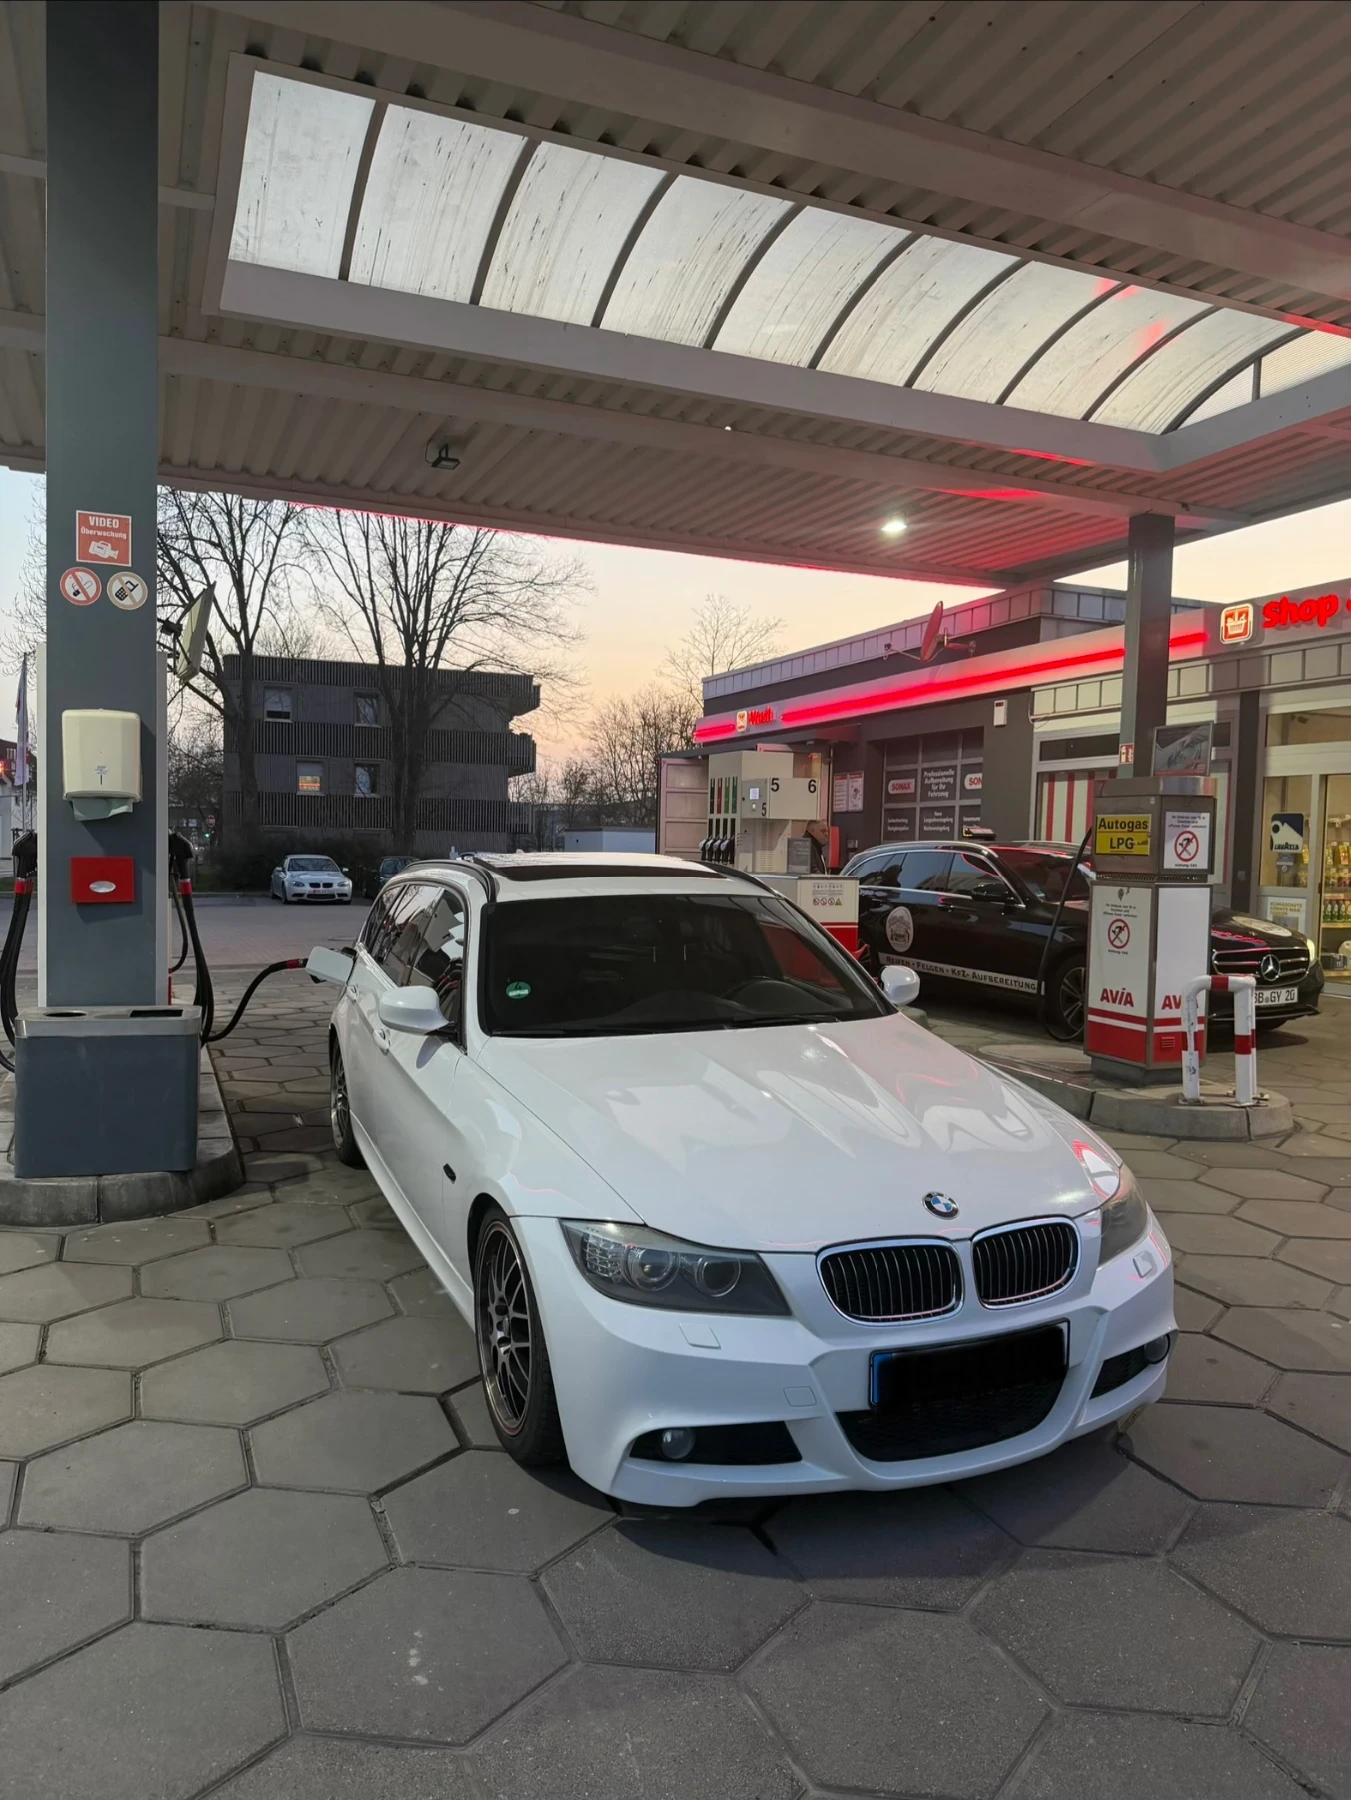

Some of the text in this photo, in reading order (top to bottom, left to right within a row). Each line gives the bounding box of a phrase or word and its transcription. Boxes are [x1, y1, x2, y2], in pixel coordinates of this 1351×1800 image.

[89, 516, 120, 528] VIDEO
[80, 526, 127, 540] Überwachung
[924, 769, 955, 777] Professionelle
[924, 776, 954, 784] Aufbereitung
[771, 778, 780, 792] 5
[808, 779, 817, 794] 6
[891, 782, 912, 791] SONAX
[927, 790, 949, 798] Fahrzeug
[761, 802, 767, 817] 5
[1098, 818, 1149, 832] Autogas
[1109, 837, 1134, 850] LPG
[886, 956, 911, 967] REIFEN
[916, 962, 945, 974] FELGEN
[972, 971, 1037, 991] AUFBEREITUNG
[1270, 991, 1282, 1003] GY
[1285, 989, 1296, 1002] 20
